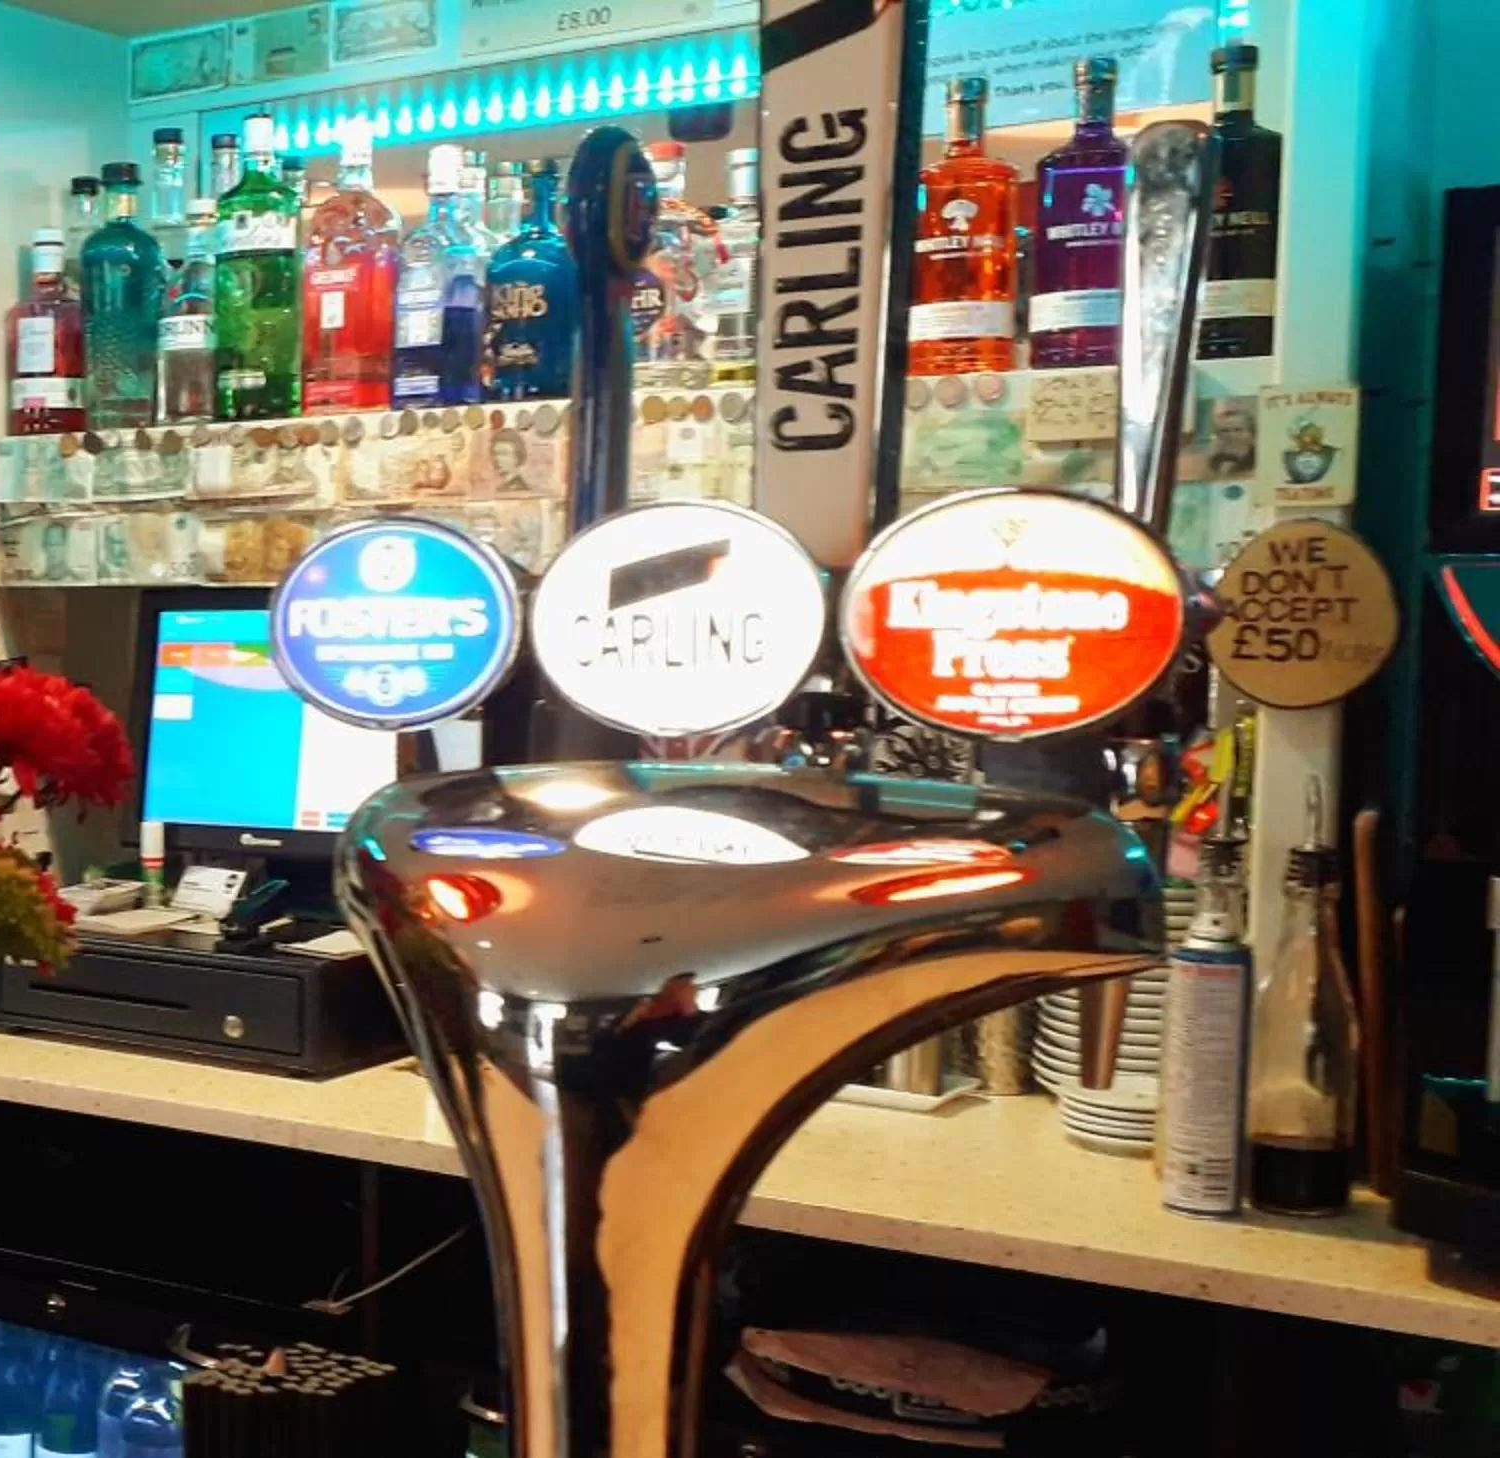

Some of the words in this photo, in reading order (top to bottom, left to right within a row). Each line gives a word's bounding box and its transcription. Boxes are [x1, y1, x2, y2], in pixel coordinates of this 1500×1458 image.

[768, 107, 869, 452] CARLING
[1268, 537, 1328, 564] WE
[1224, 597, 1360, 624] ACCEPT
[574, 612, 766, 670] CARLING
[1231, 623, 1321, 662] £50
